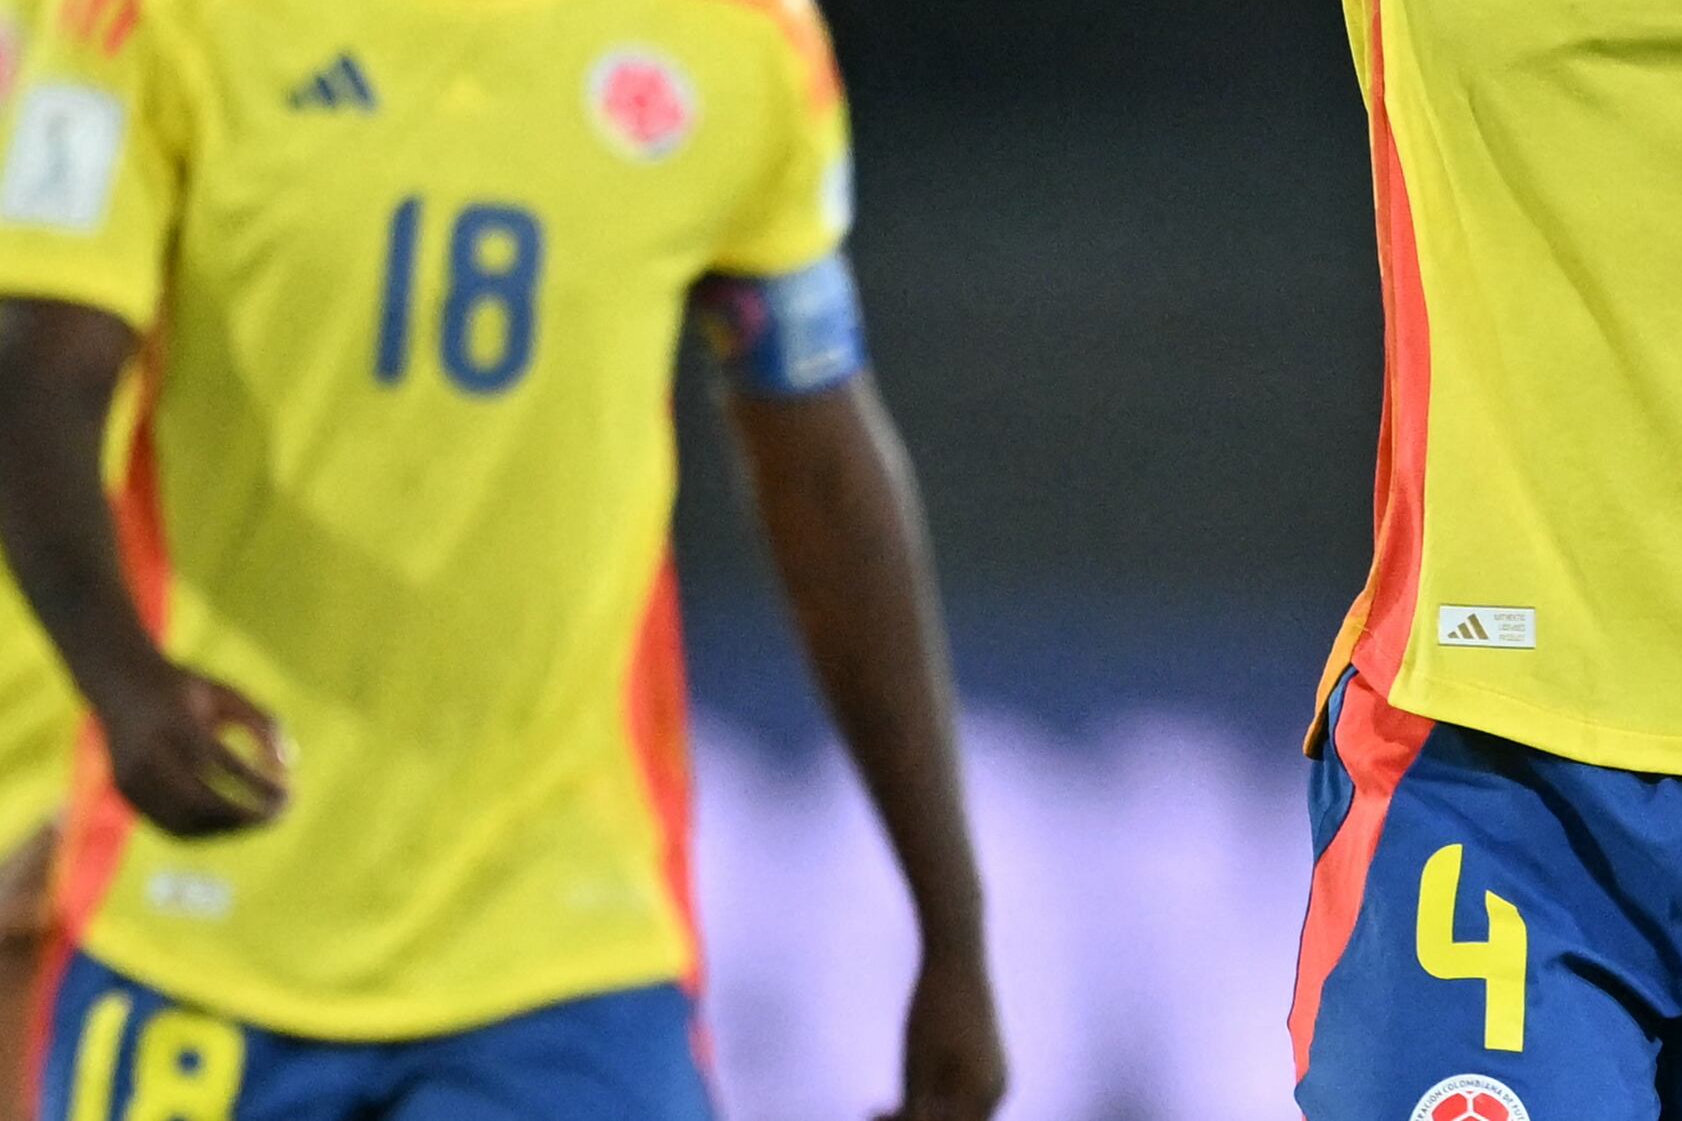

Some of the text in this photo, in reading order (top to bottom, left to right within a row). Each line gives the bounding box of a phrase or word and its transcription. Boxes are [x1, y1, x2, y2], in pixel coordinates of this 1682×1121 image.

[372, 192, 547, 397] 18
[1416, 843, 1527, 1052] 4
[66, 990, 247, 1121] 18
